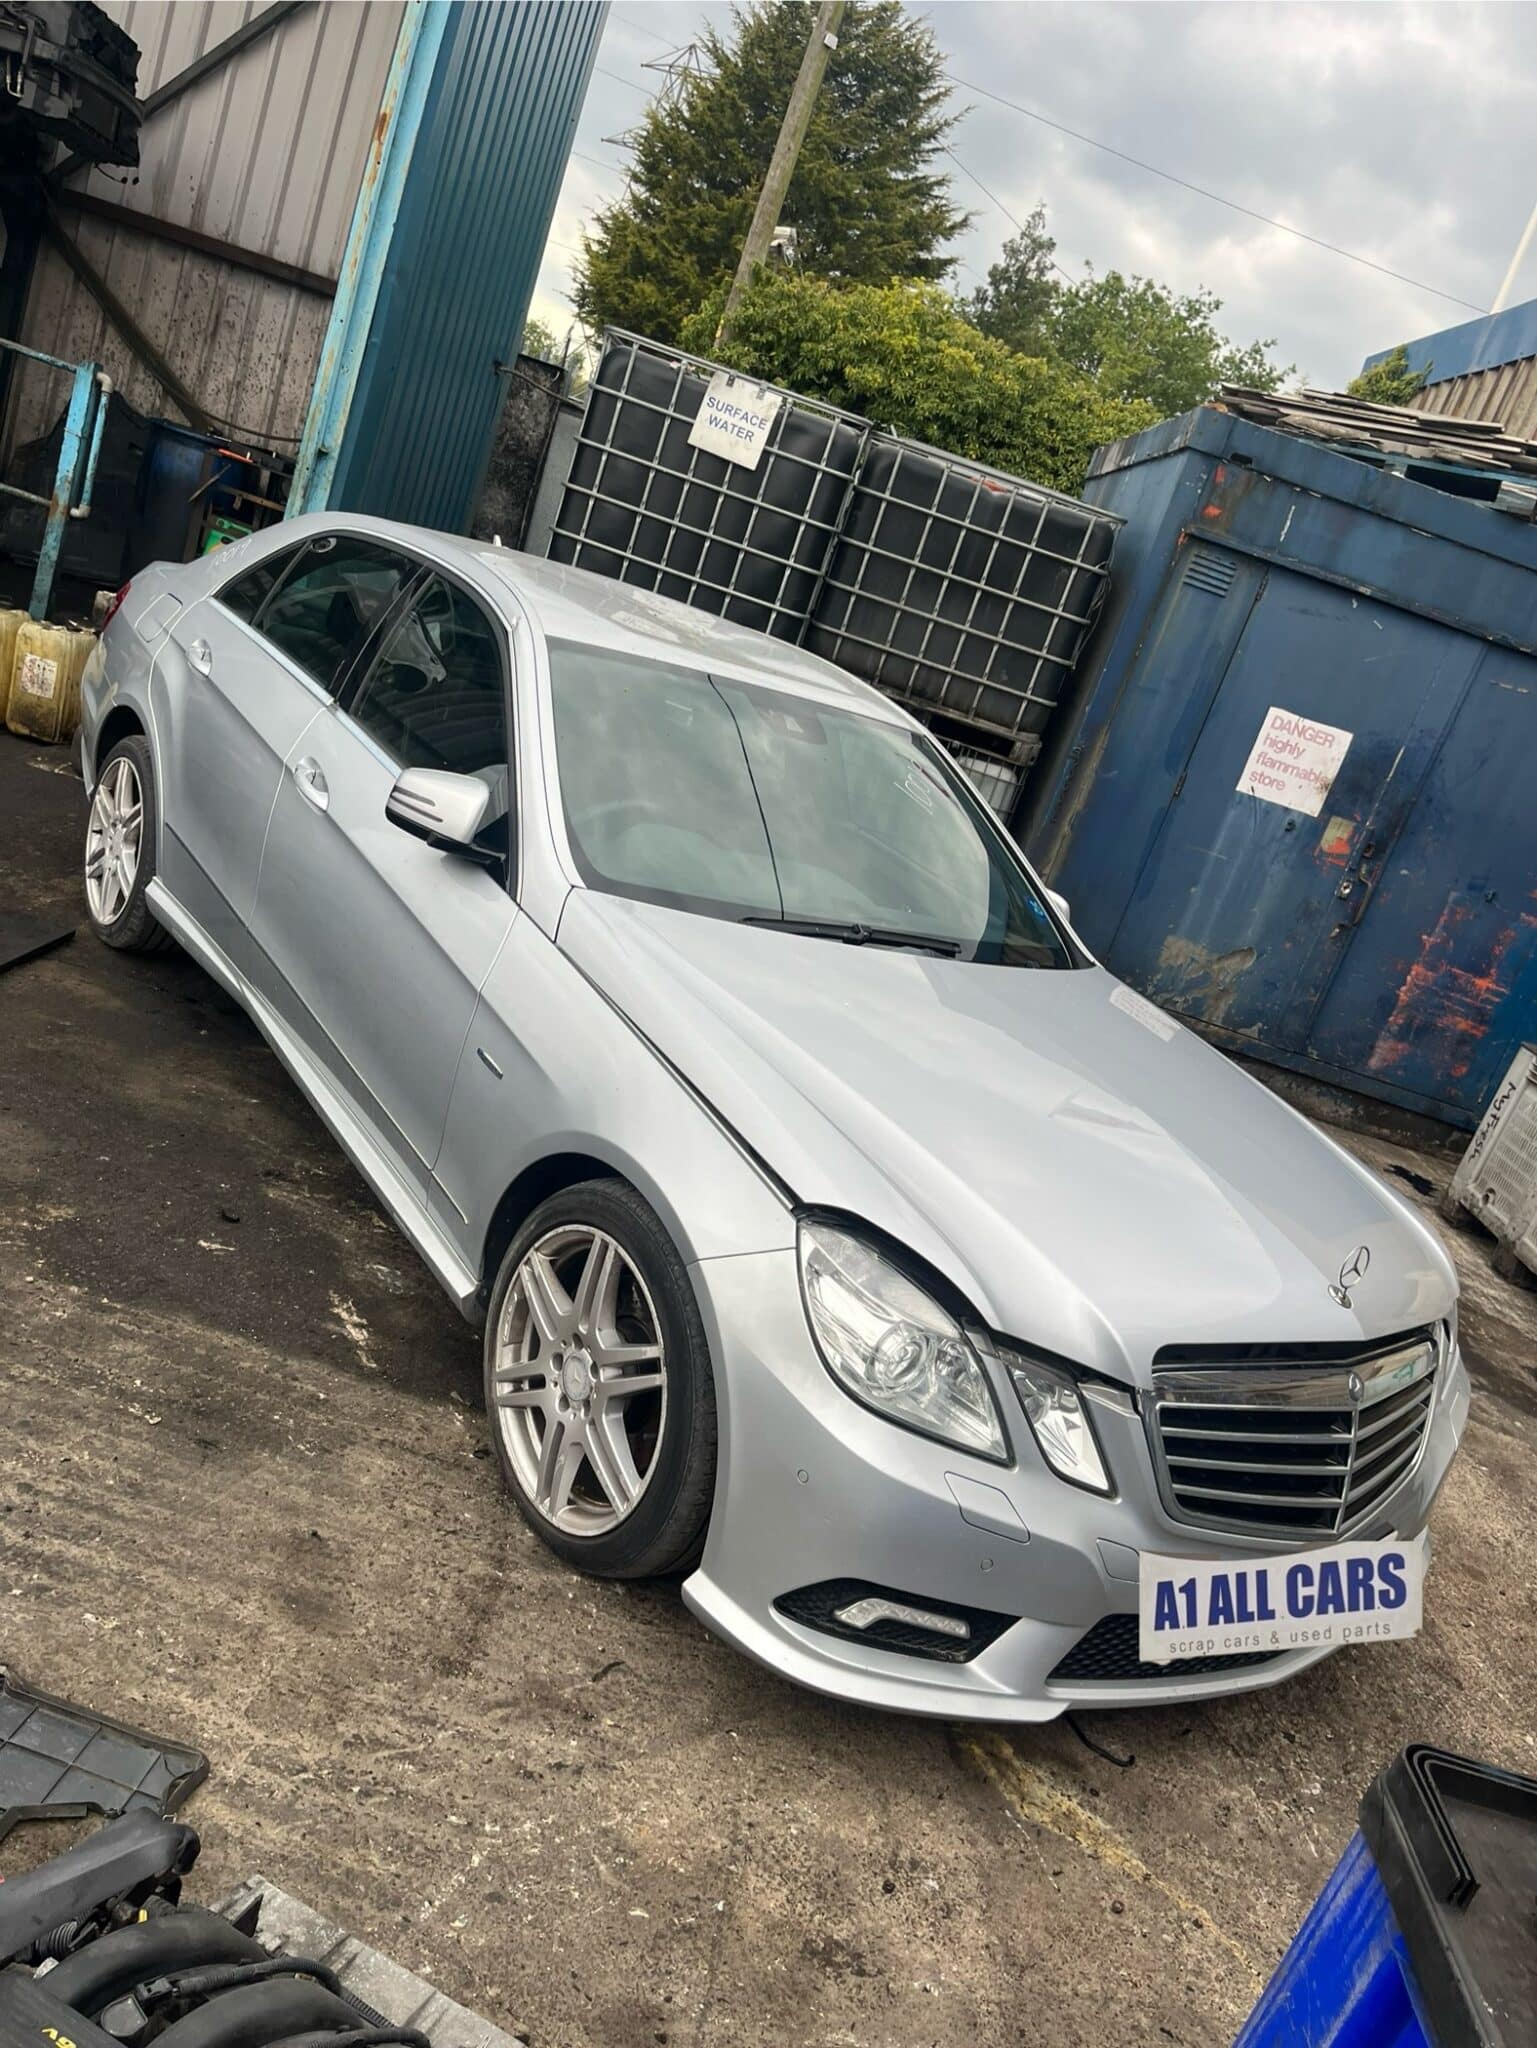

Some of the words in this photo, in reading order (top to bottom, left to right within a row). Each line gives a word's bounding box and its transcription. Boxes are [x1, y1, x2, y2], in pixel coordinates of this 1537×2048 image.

[706, 396, 768, 431] SURFACE
[708, 413, 755, 443] WATER
[1263, 732, 1306, 760] highly
[1270, 715, 1335, 748] DANGER
[1248, 769, 1286, 791] store
[1153, 1577, 1198, 1631] A1
[1207, 1569, 1276, 1626] ALL
[1285, 1553, 1407, 1618] CARS
[1168, 1638, 1215, 1653] scrap
[1223, 1632, 1260, 1649] cars
[1269, 1630, 1280, 1645] &
[1289, 1623, 1332, 1642] used
[1342, 1620, 1391, 1641] parts
